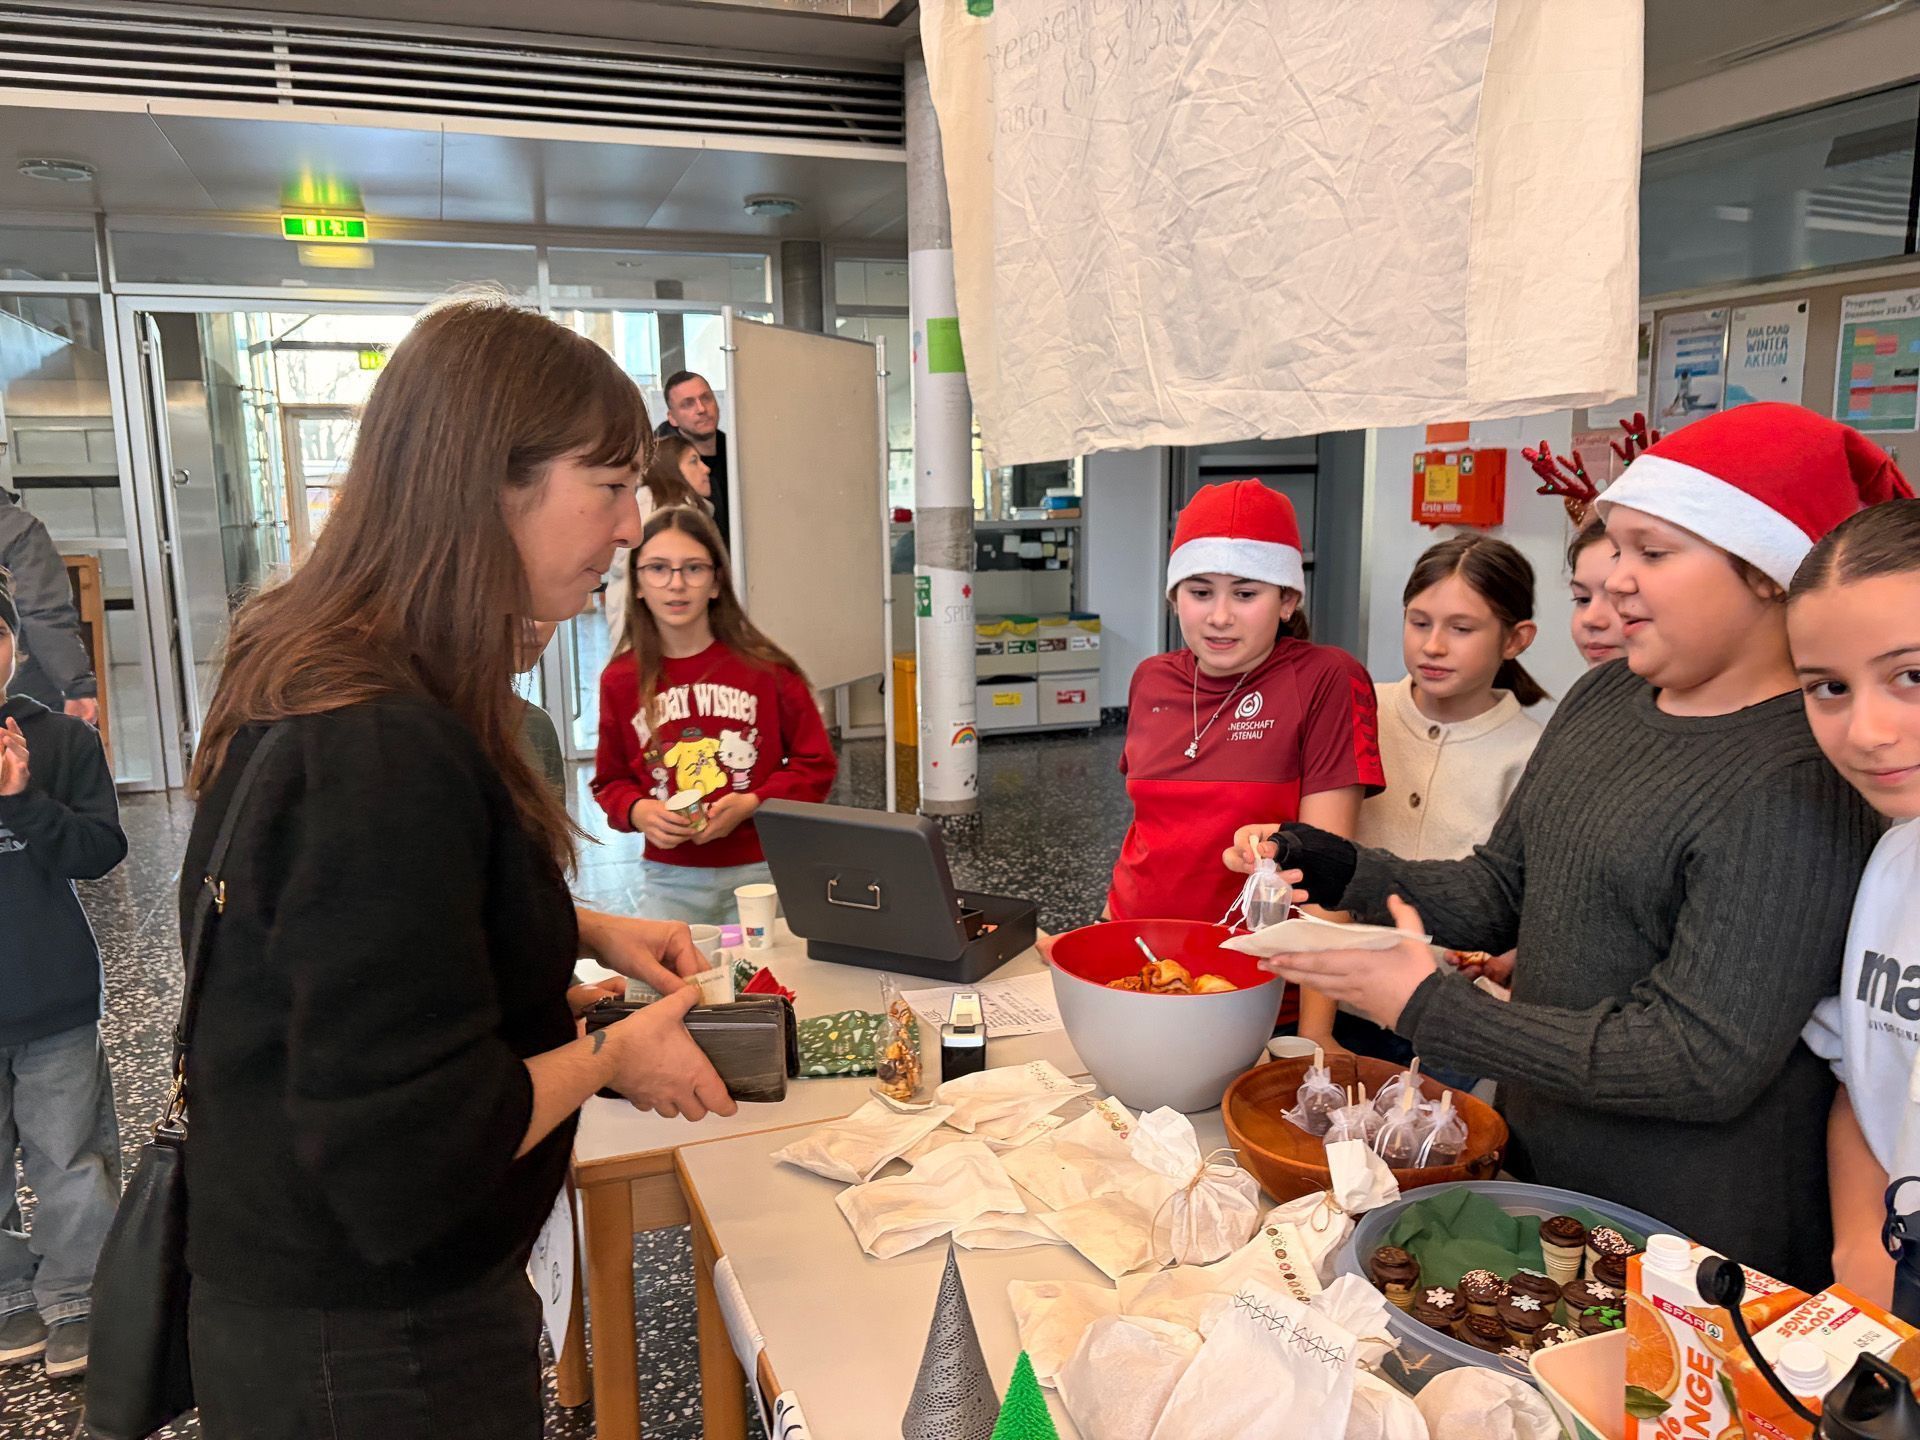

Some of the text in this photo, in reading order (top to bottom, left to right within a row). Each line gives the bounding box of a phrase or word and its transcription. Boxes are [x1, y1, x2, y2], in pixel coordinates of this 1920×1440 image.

[1746, 335, 1789, 353] WINTER
[1744, 351, 1788, 369] AKTION
[1421, 502, 1463, 513] Erste Hilfe
[1228, 719, 1275, 731] NERSCHAFT
[1659, 1301, 1706, 1332] SPAR
[1776, 1293, 1828, 1339] ORANGE
[1798, 1306, 1836, 1336] 100%
